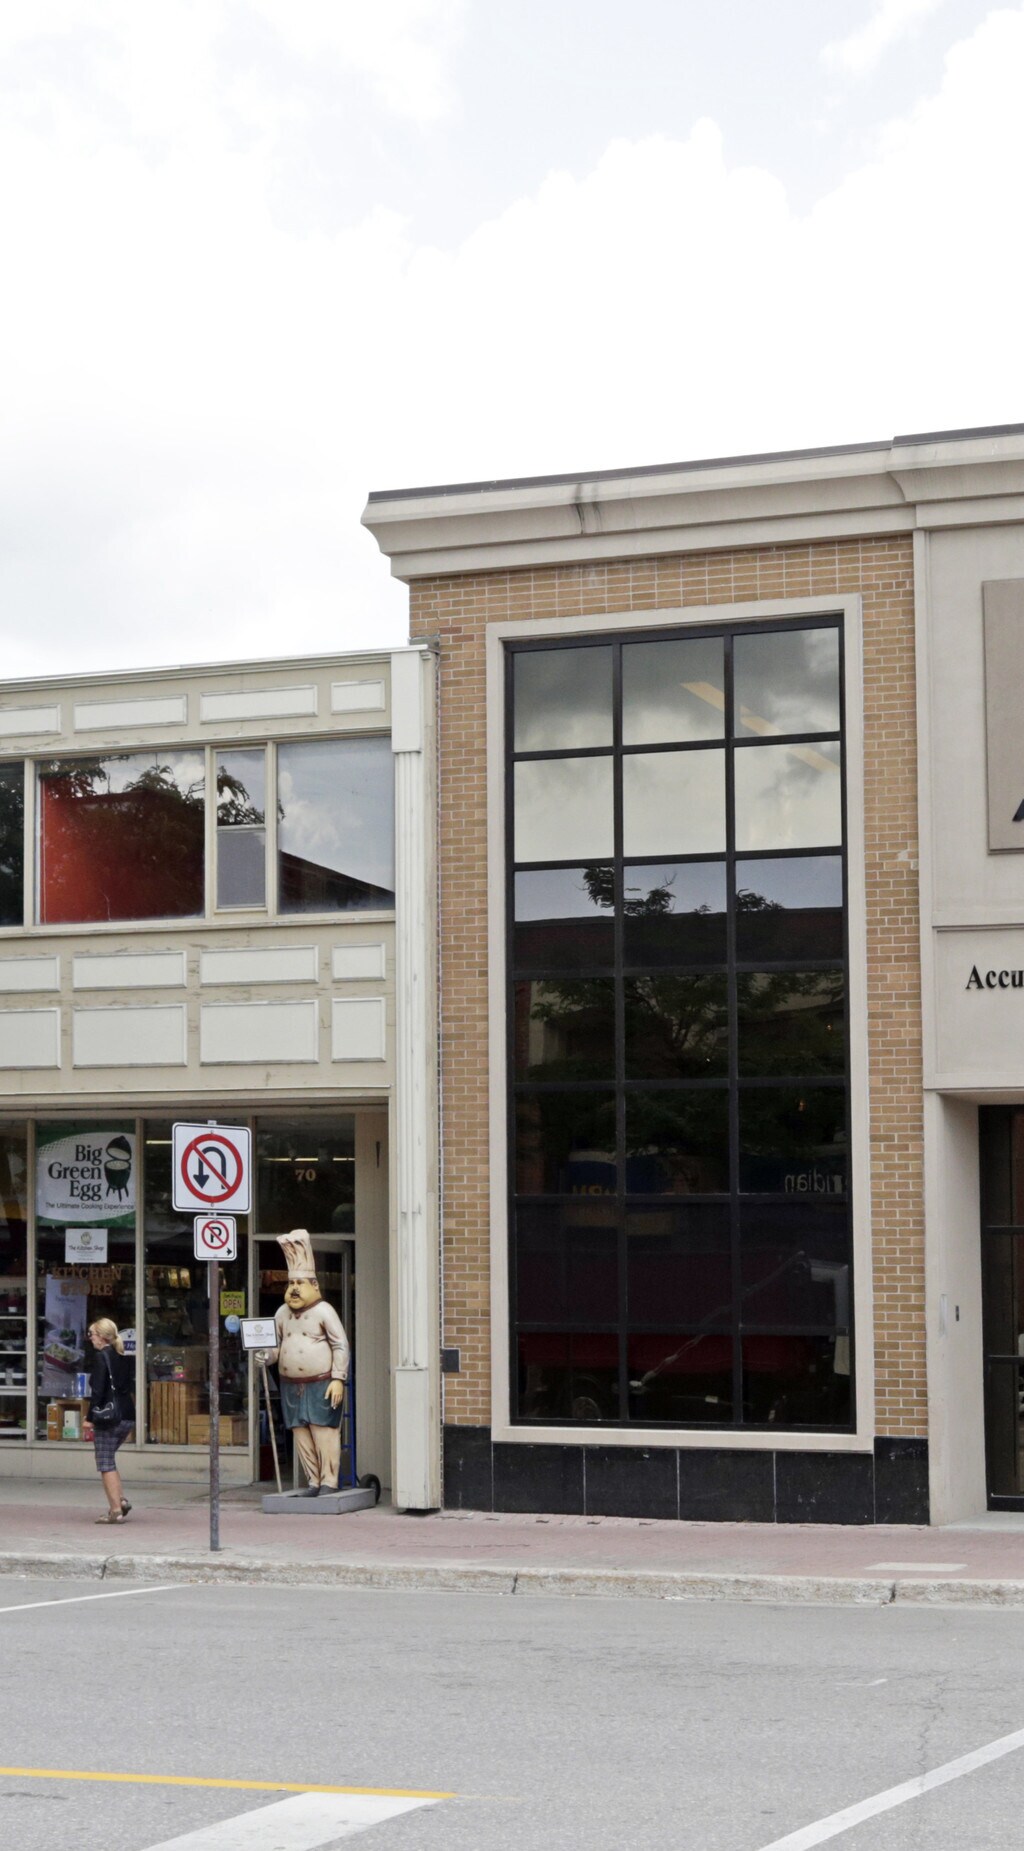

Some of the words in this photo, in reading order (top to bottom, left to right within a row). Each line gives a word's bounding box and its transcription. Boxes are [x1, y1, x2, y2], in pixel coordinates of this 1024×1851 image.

[75, 1144, 103, 1166] Big
[48, 1162, 102, 1180] Green
[295, 1168, 316, 1181] 70
[69, 1180, 102, 1202] Egg
[81, 1202, 103, 1210] Cooking
[52, 1266, 122, 1280] KITCHEN
[223, 1299, 242, 1309] OPEN
